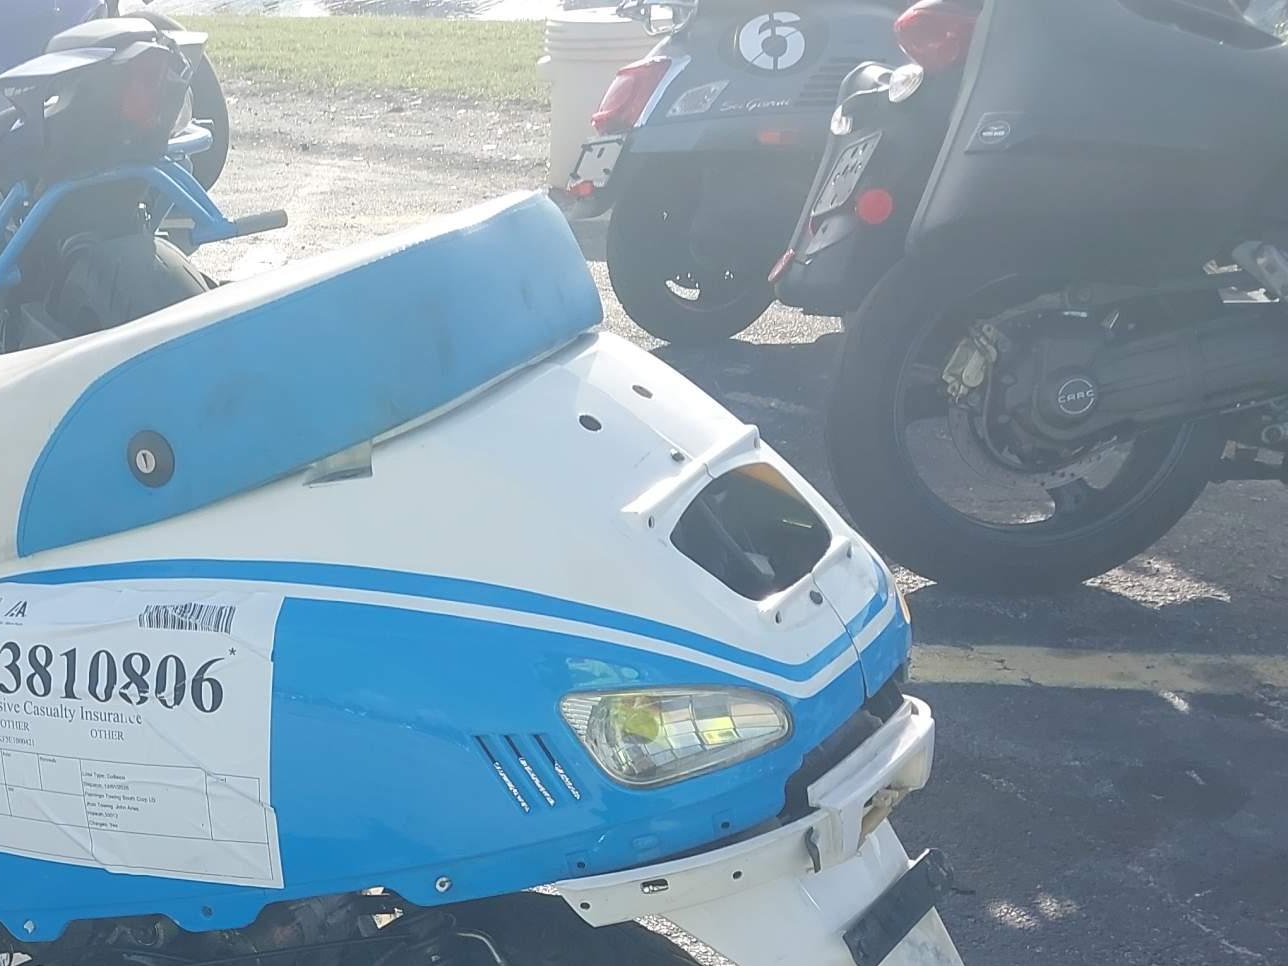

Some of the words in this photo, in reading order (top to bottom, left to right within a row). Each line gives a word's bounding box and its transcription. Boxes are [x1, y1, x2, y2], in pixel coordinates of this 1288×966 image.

[739, 11, 805, 70] 6
[23, 701, 76, 723] Casualty
[0, 719, 30, 732] OTHER
[90, 728, 124, 741] OTHER
